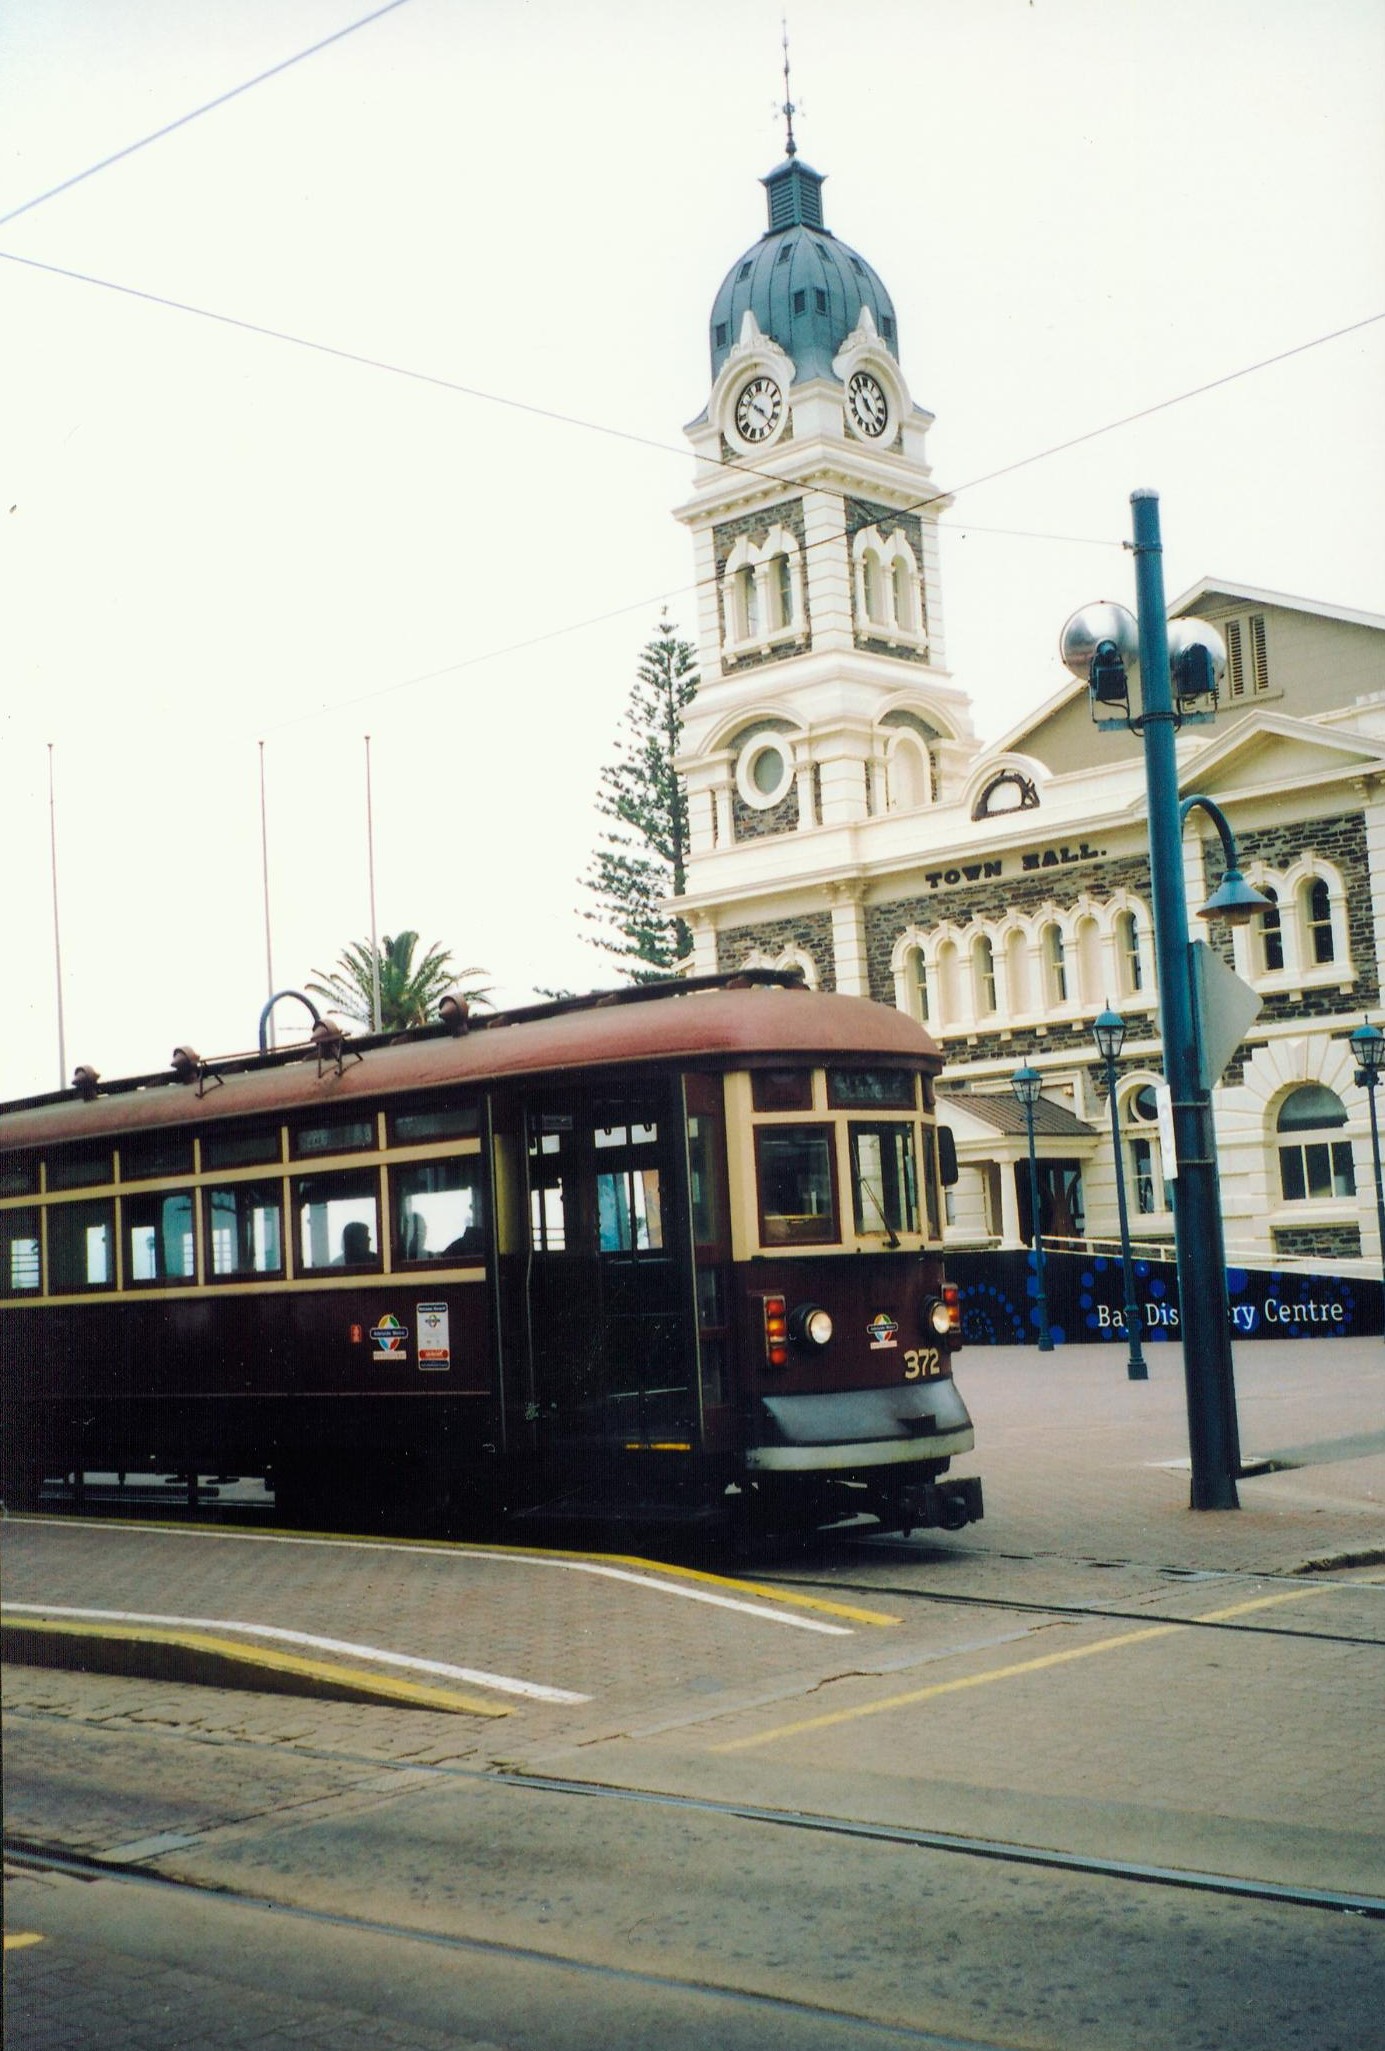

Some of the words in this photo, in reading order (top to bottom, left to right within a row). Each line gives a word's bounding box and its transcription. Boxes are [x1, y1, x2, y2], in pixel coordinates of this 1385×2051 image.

[925, 859, 1002, 888] TOWN
[1097, 1304, 1131, 1333] Ba
[1145, 1301, 1256, 1330] Disry
[1264, 1298, 1343, 1323] Centre
[903, 1347, 940, 1379] 372
